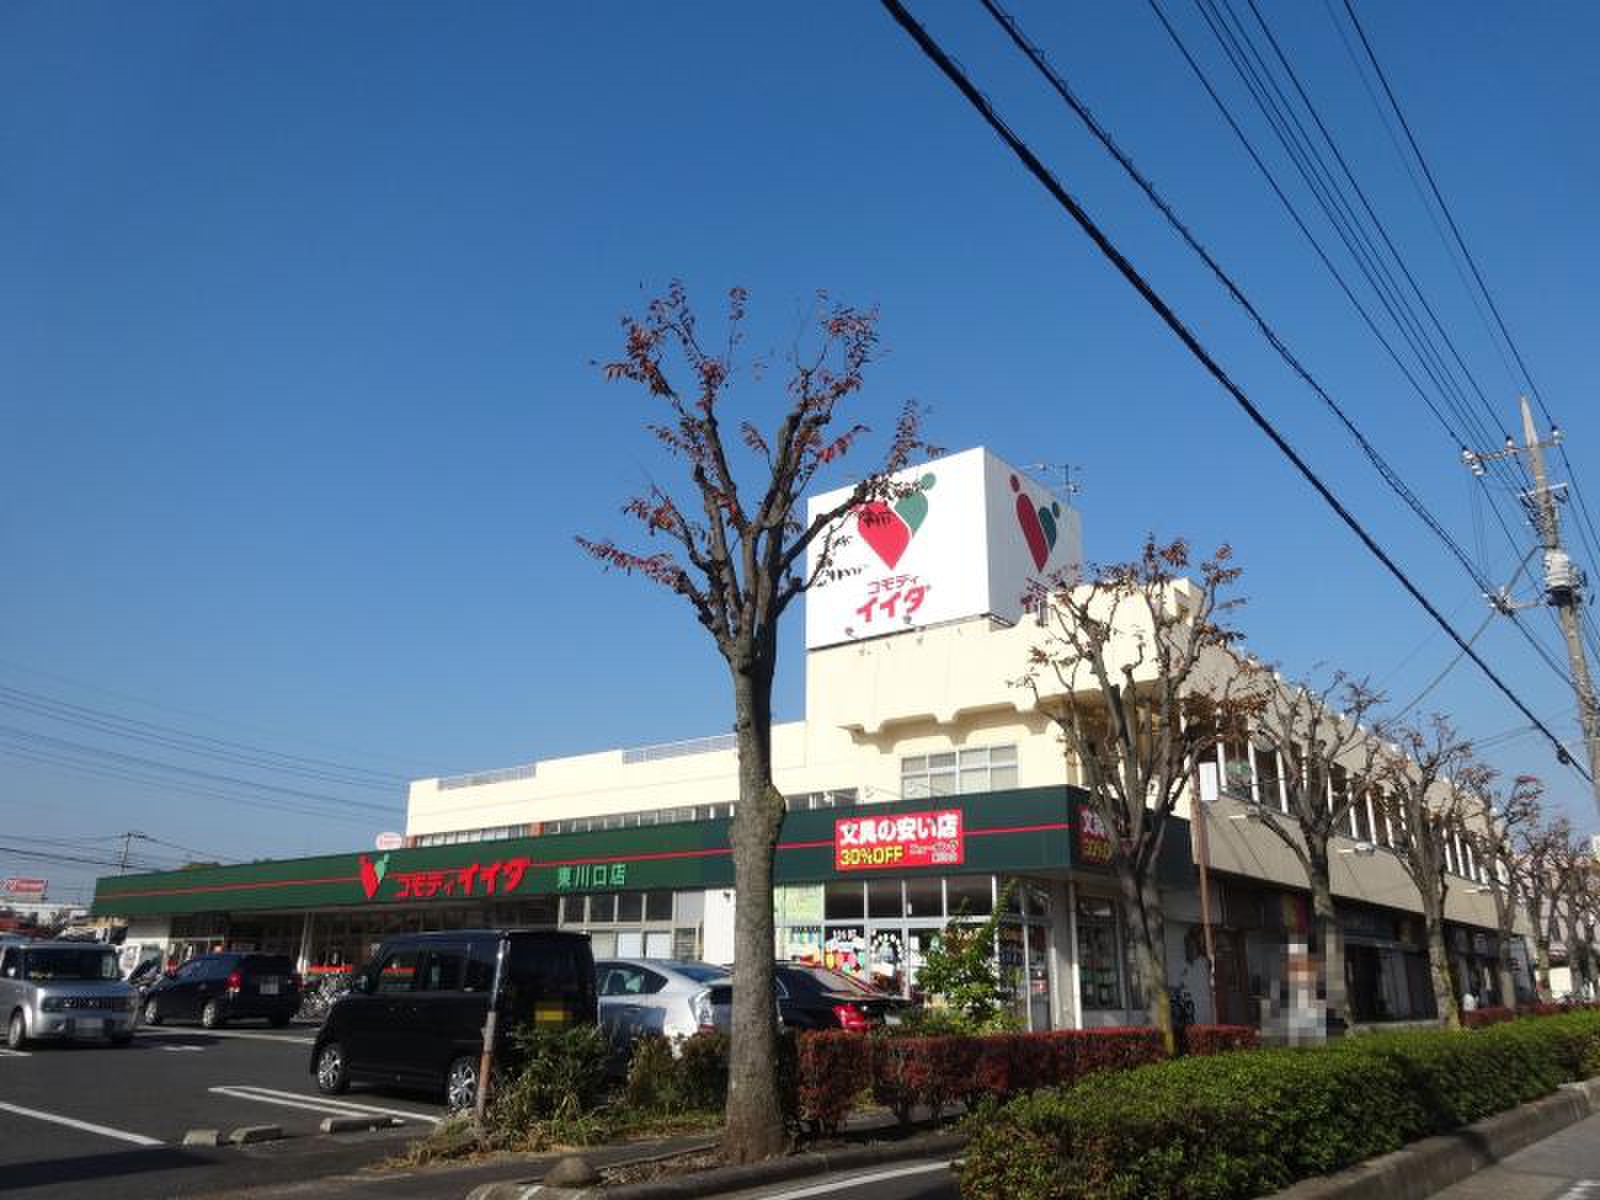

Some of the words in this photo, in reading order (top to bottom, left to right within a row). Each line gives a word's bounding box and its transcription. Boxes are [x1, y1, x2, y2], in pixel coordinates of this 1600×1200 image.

[856, 585, 926, 623] イイダ
[840, 813, 958, 846] 文具の安い店
[840, 844, 904, 865] 30%OFF
[556, 863, 626, 890] 東川口店
